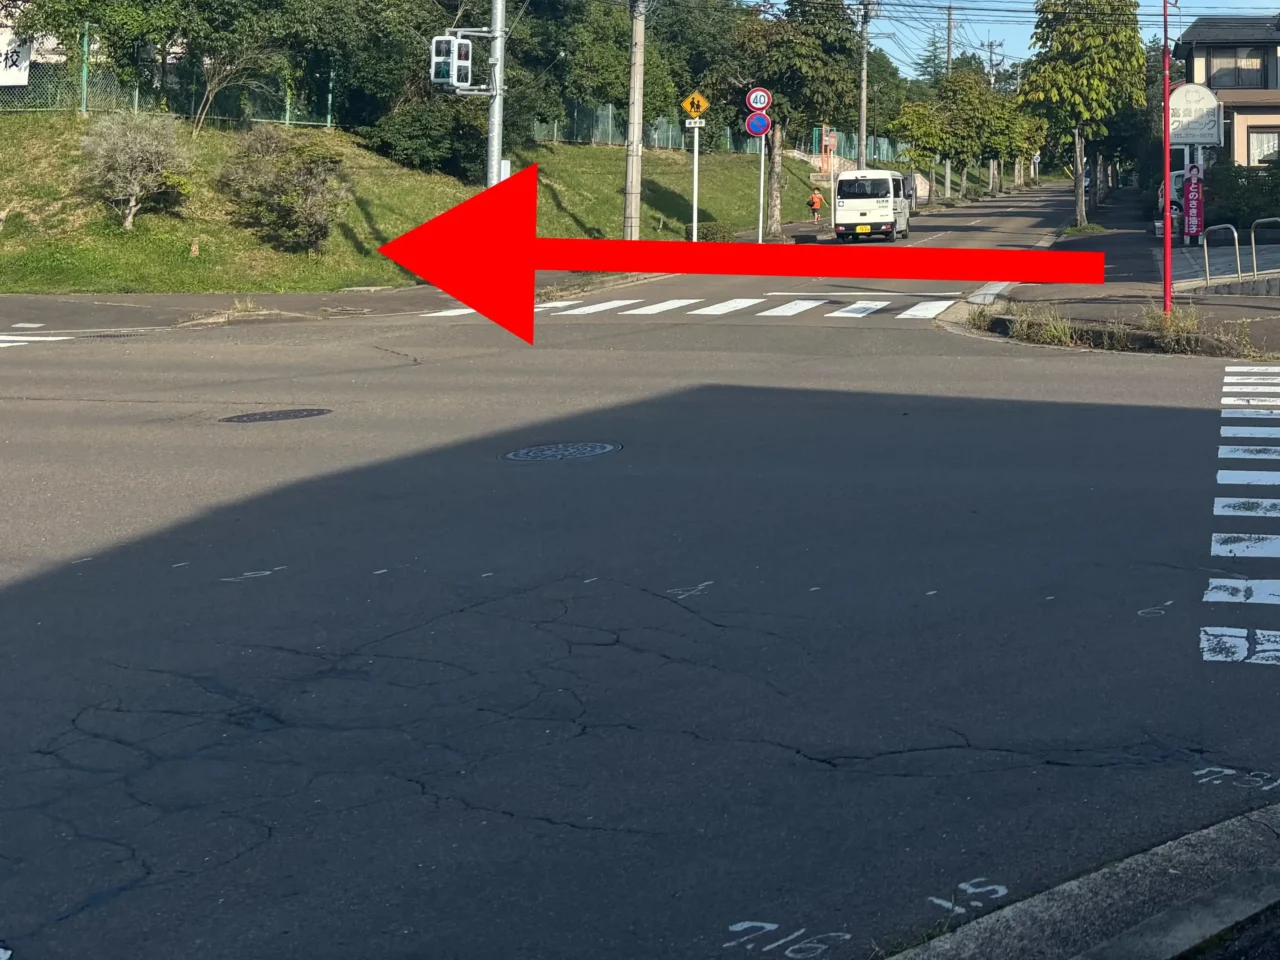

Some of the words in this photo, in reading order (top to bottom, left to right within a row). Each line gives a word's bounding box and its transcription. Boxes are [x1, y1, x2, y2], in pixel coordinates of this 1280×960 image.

[0, 49, 20, 69] 校
[752, 94, 766, 105] 40
[1171, 108, 1216, 118] 高森歯科
[1171, 120, 1217, 130] クリニック
